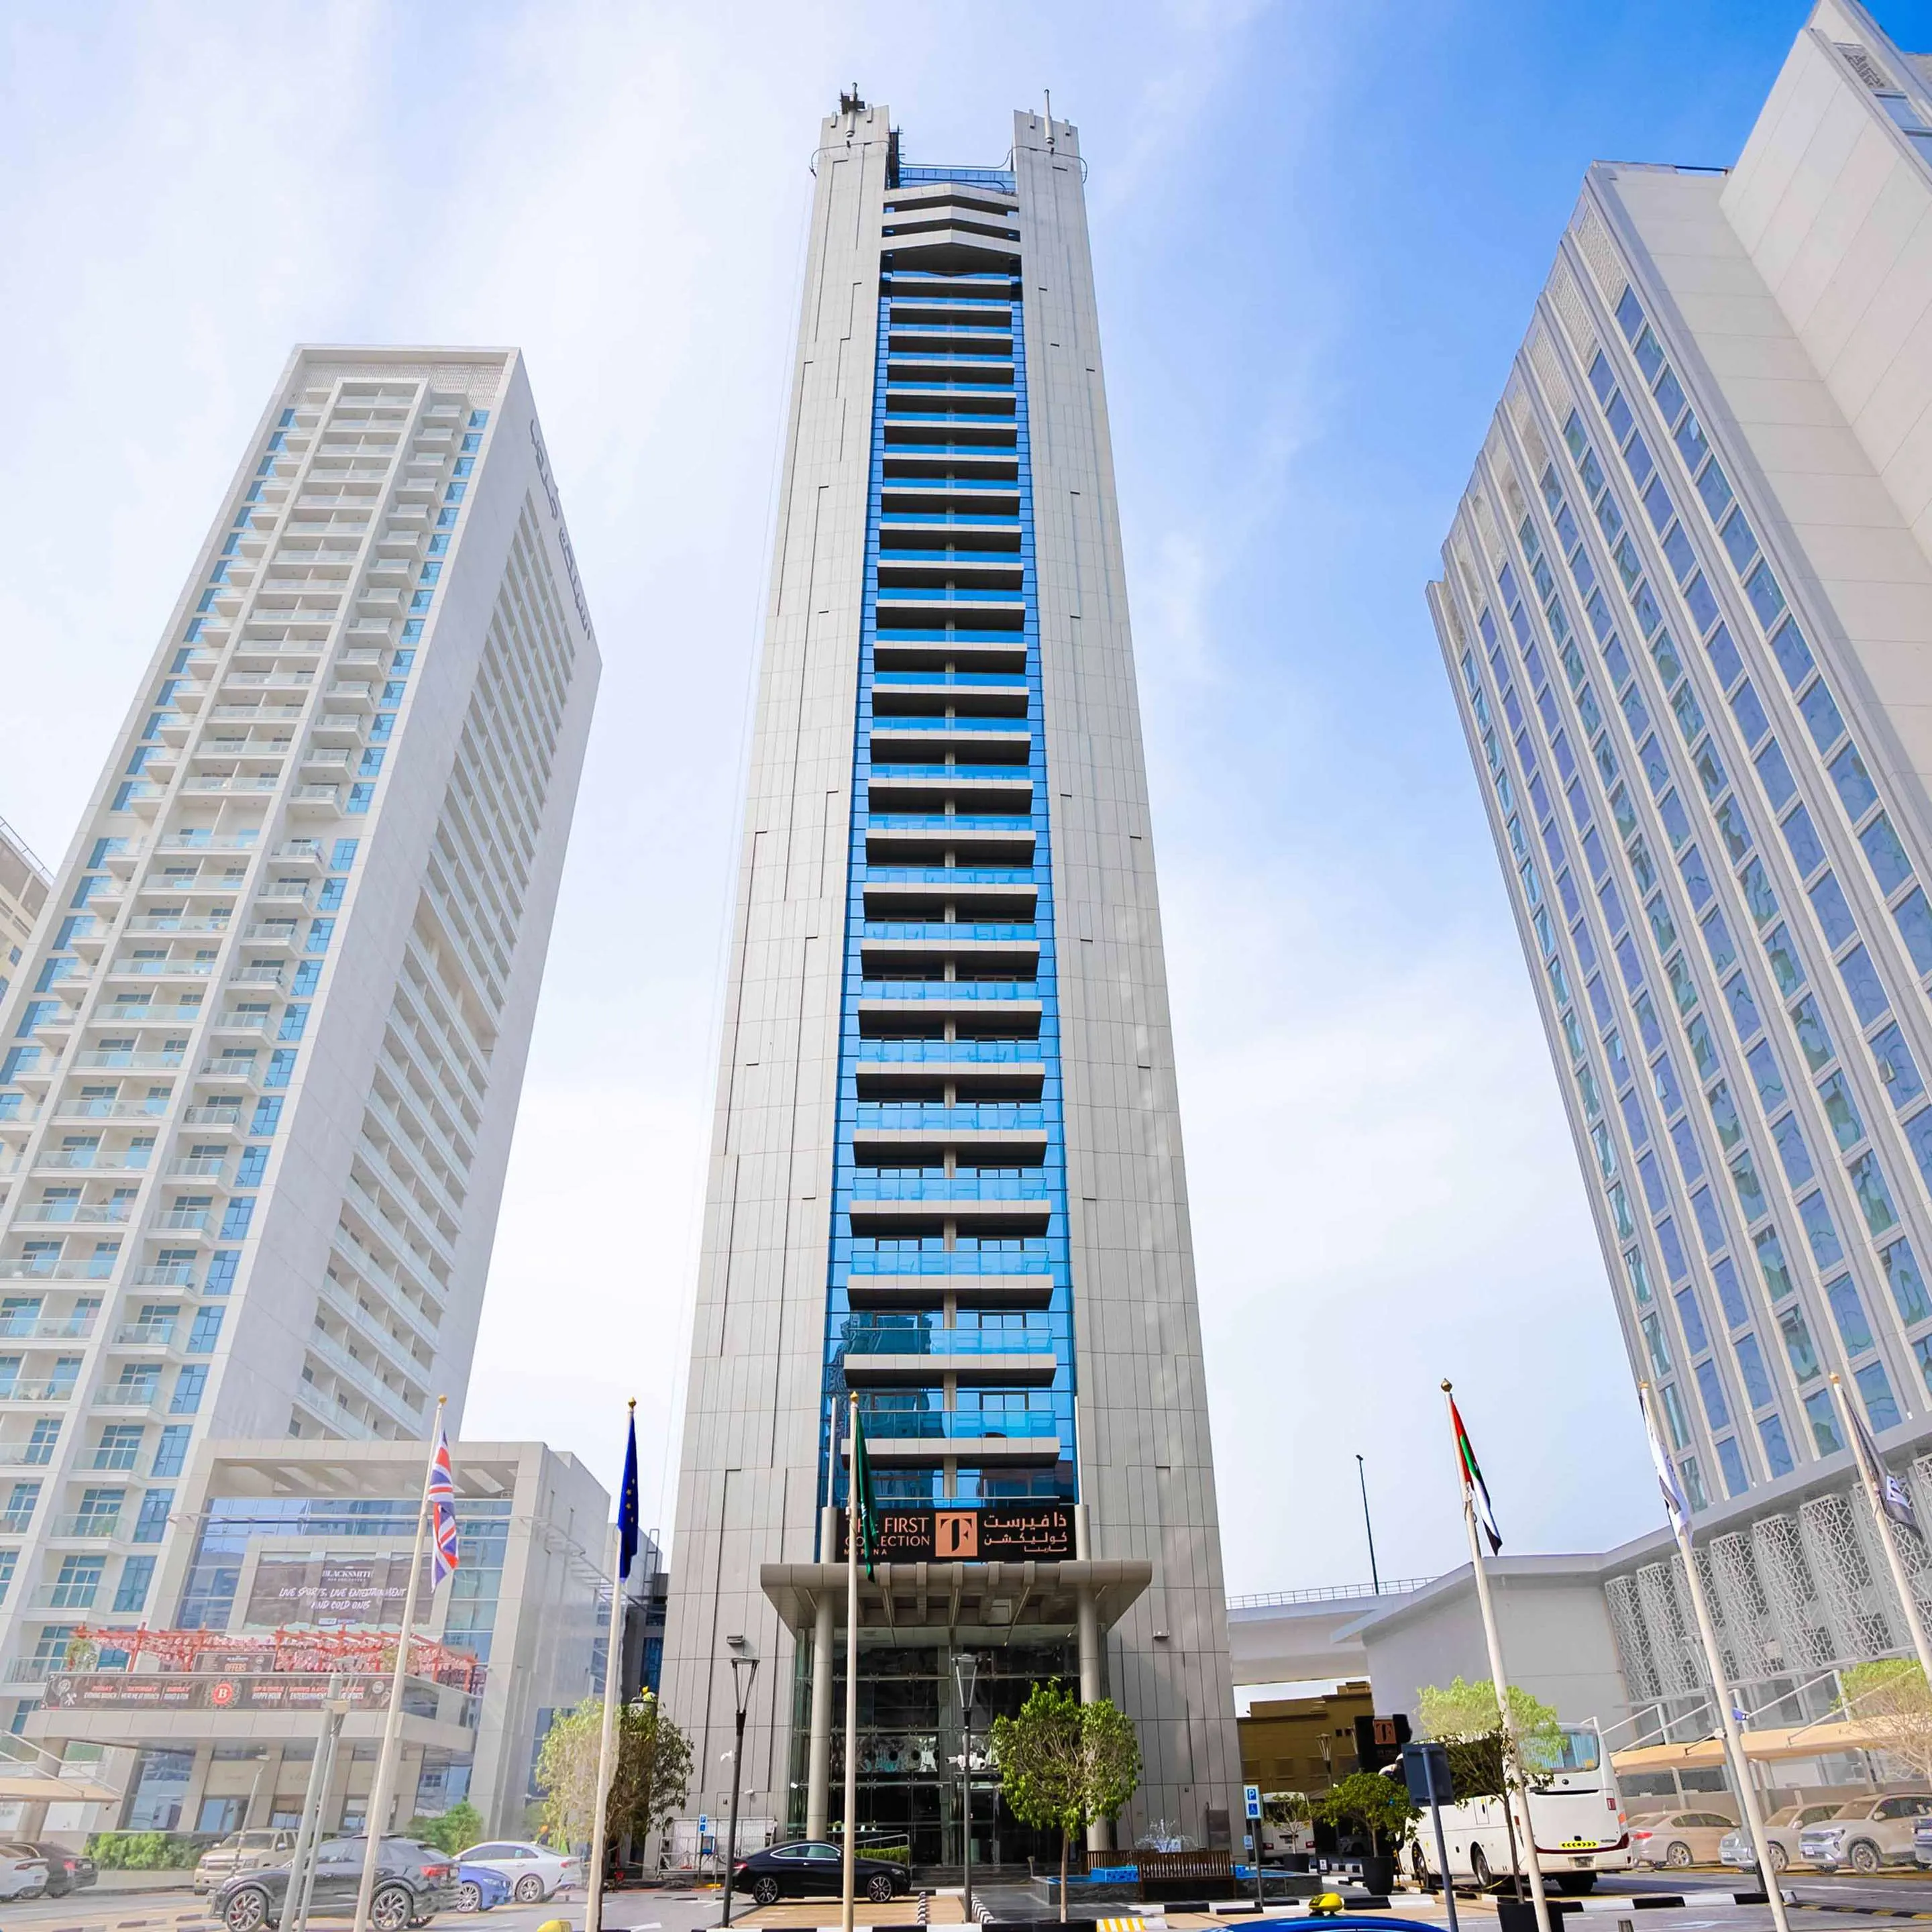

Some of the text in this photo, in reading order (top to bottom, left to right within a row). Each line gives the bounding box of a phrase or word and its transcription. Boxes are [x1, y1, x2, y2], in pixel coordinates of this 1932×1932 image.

[885, 1517, 929, 1533] FIRST
[983, 1511, 1067, 1531] ذا فيرست
[845, 1536, 930, 1546] COECTION
[983, 1532, 1067, 1546] كوليكشن
[279, 1587, 297, 1597] LIVE
[329, 1588, 347, 1597] LIVE
[349, 1587, 407, 1597] ENTERTAINMENT
[311, 1601, 330, 1609] AND
[331, 1601, 350, 1610] COLD
[217, 1688, 229, 1699] B
[1248, 1789, 1254, 1799] P
